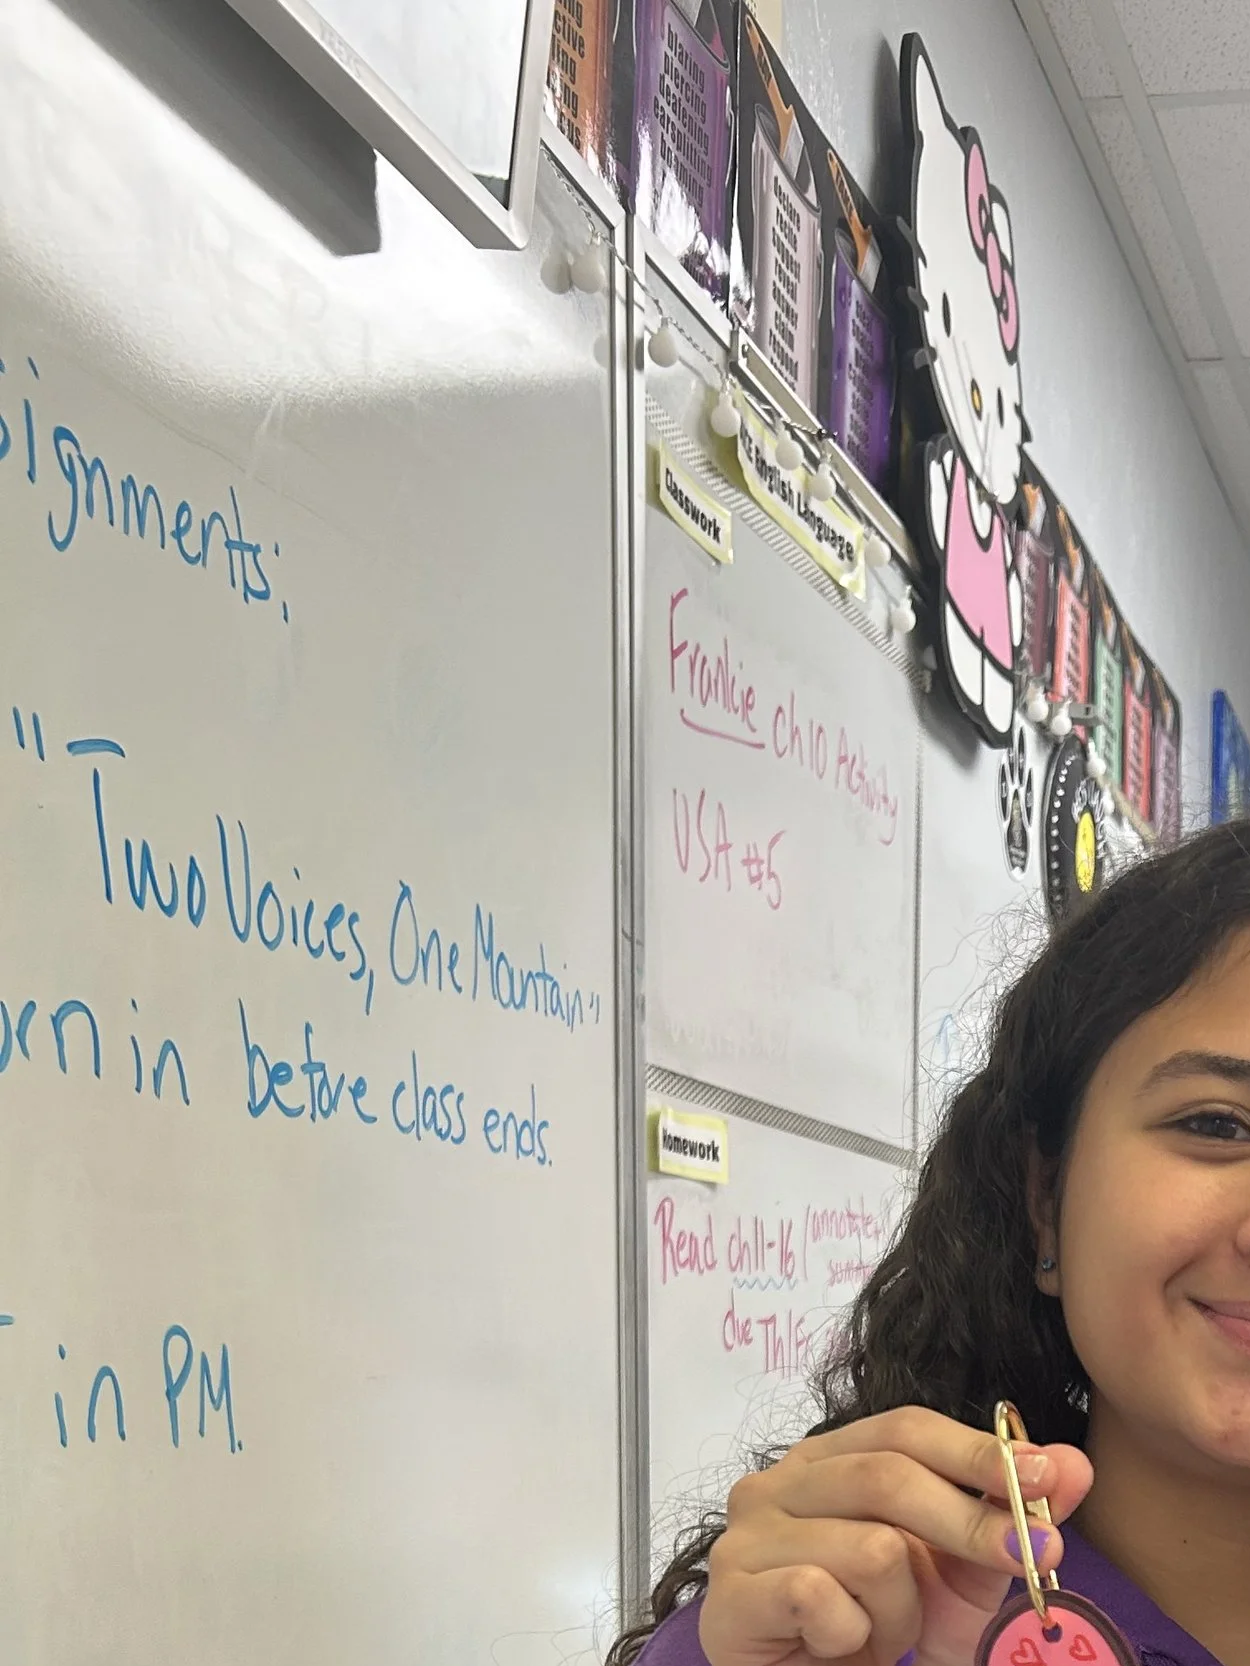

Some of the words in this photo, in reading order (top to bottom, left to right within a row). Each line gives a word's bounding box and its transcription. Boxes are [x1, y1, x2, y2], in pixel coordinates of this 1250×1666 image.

[663, 50, 707, 125] piercing
[667, 22, 705, 94] blaring
[654, 95, 713, 188] earsplitting
[659, 72, 709, 156] deafening
[773, 175, 801, 233] declare
[772, 279, 799, 331] answer
[774, 256, 797, 305] reveal
[774, 310, 795, 352] claim
[755, 443, 794, 511] English
[797, 491, 855, 562] Language
[668, 588, 758, 733] Frankie
[835, 726, 898, 846] Activity
[673, 788, 733, 893] USA
[741, 829, 788, 912] #5
[388, 879, 463, 997] One
[130, 998, 190, 1106] in
[238, 998, 378, 1123] before
[391, 1050, 467, 1142] class
[661, 1126, 721, 1164] Homework
[653, 1196, 718, 1286] Read
[54, 1343, 126, 1449] in
